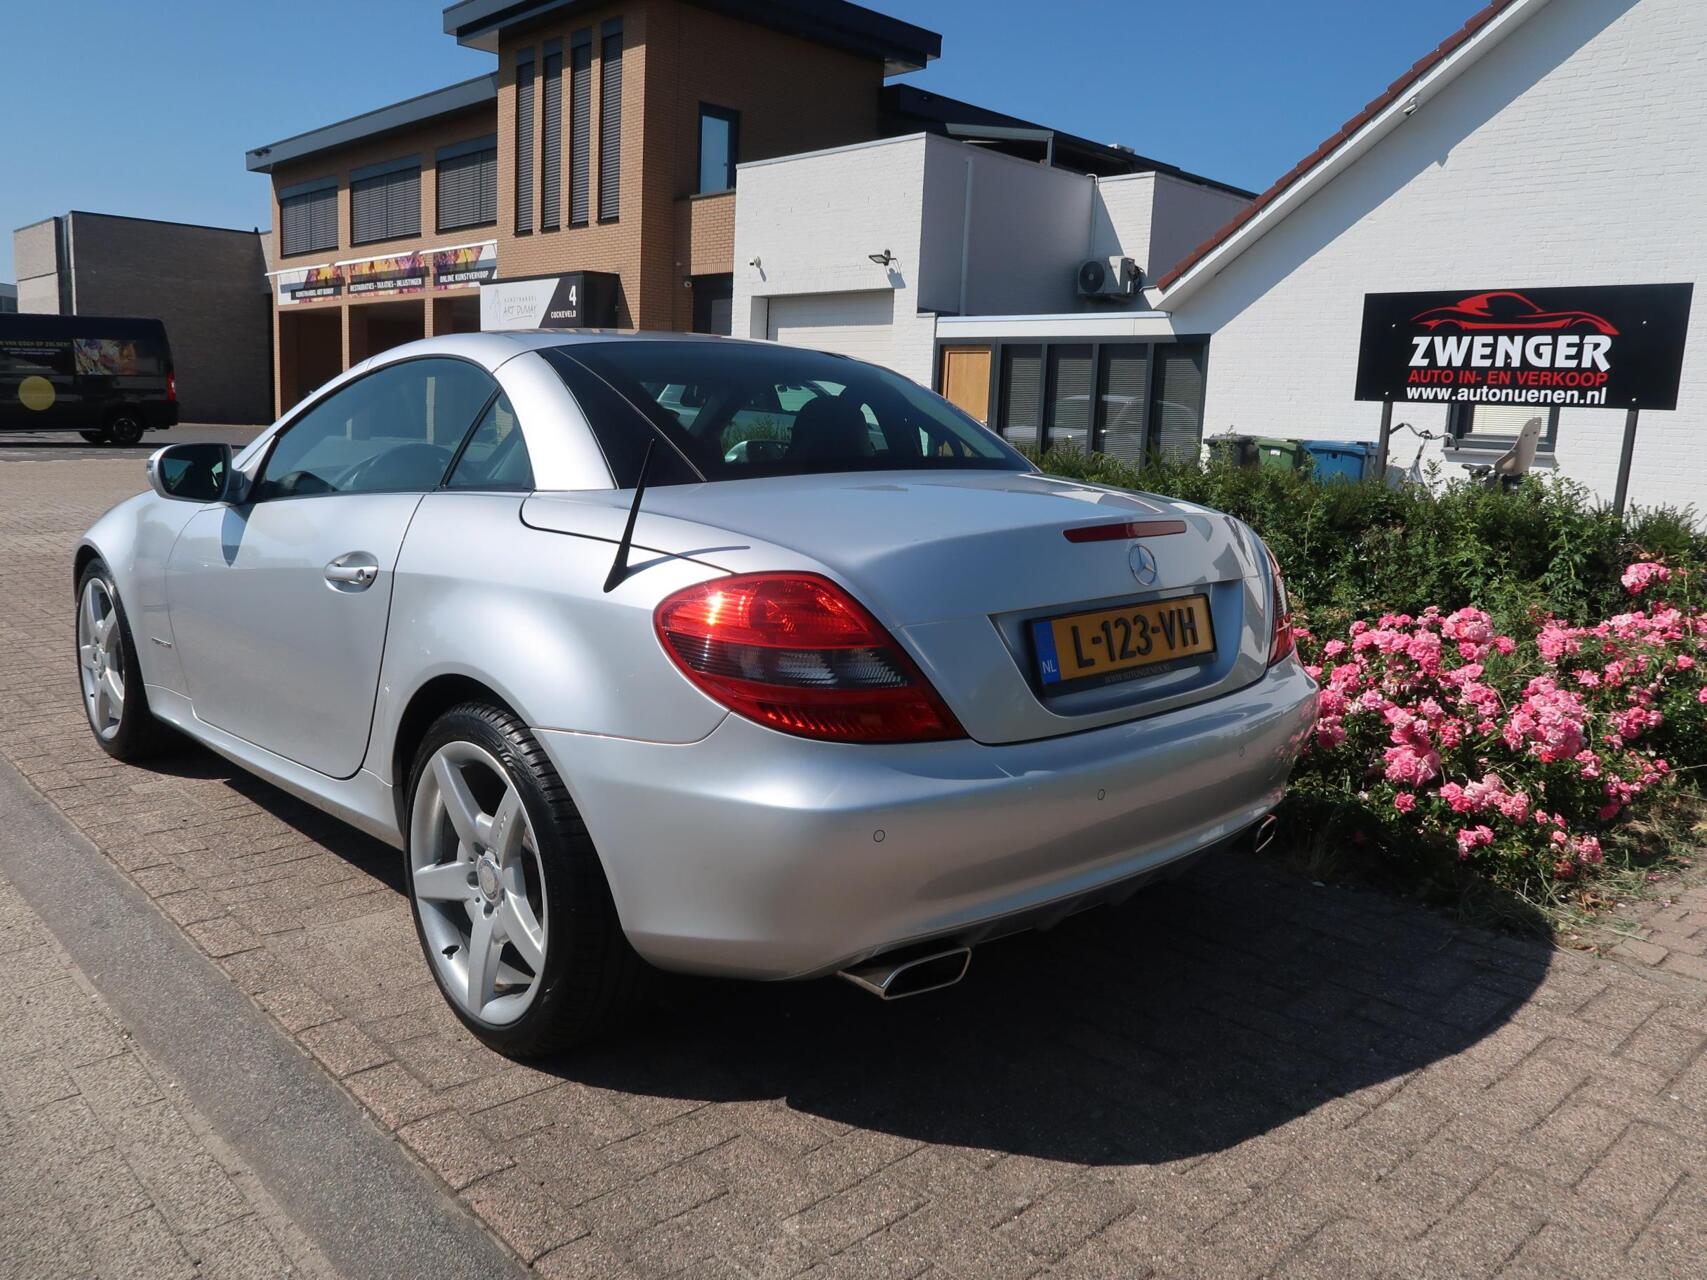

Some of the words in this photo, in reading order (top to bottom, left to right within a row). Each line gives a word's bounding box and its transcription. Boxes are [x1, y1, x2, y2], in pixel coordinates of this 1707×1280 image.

[440, 274, 454, 283] ONLINE
[455, 270, 489, 281] KUNSTVERKOOP
[569, 285, 577, 306] 4
[550, 310, 577, 319] COCKEVELD
[1408, 335, 1612, 373] ZWENGER
[1408, 369, 1454, 384] AUTO
[1459, 371, 1482, 384] IN-
[1487, 371, 1511, 385] EN
[1516, 371, 1609, 387] VERKOOP
[1406, 385, 1607, 404] www.autonuenen.nl
[1071, 606, 1199, 669] L-123-VH
[1041, 660, 1057, 675] NL
